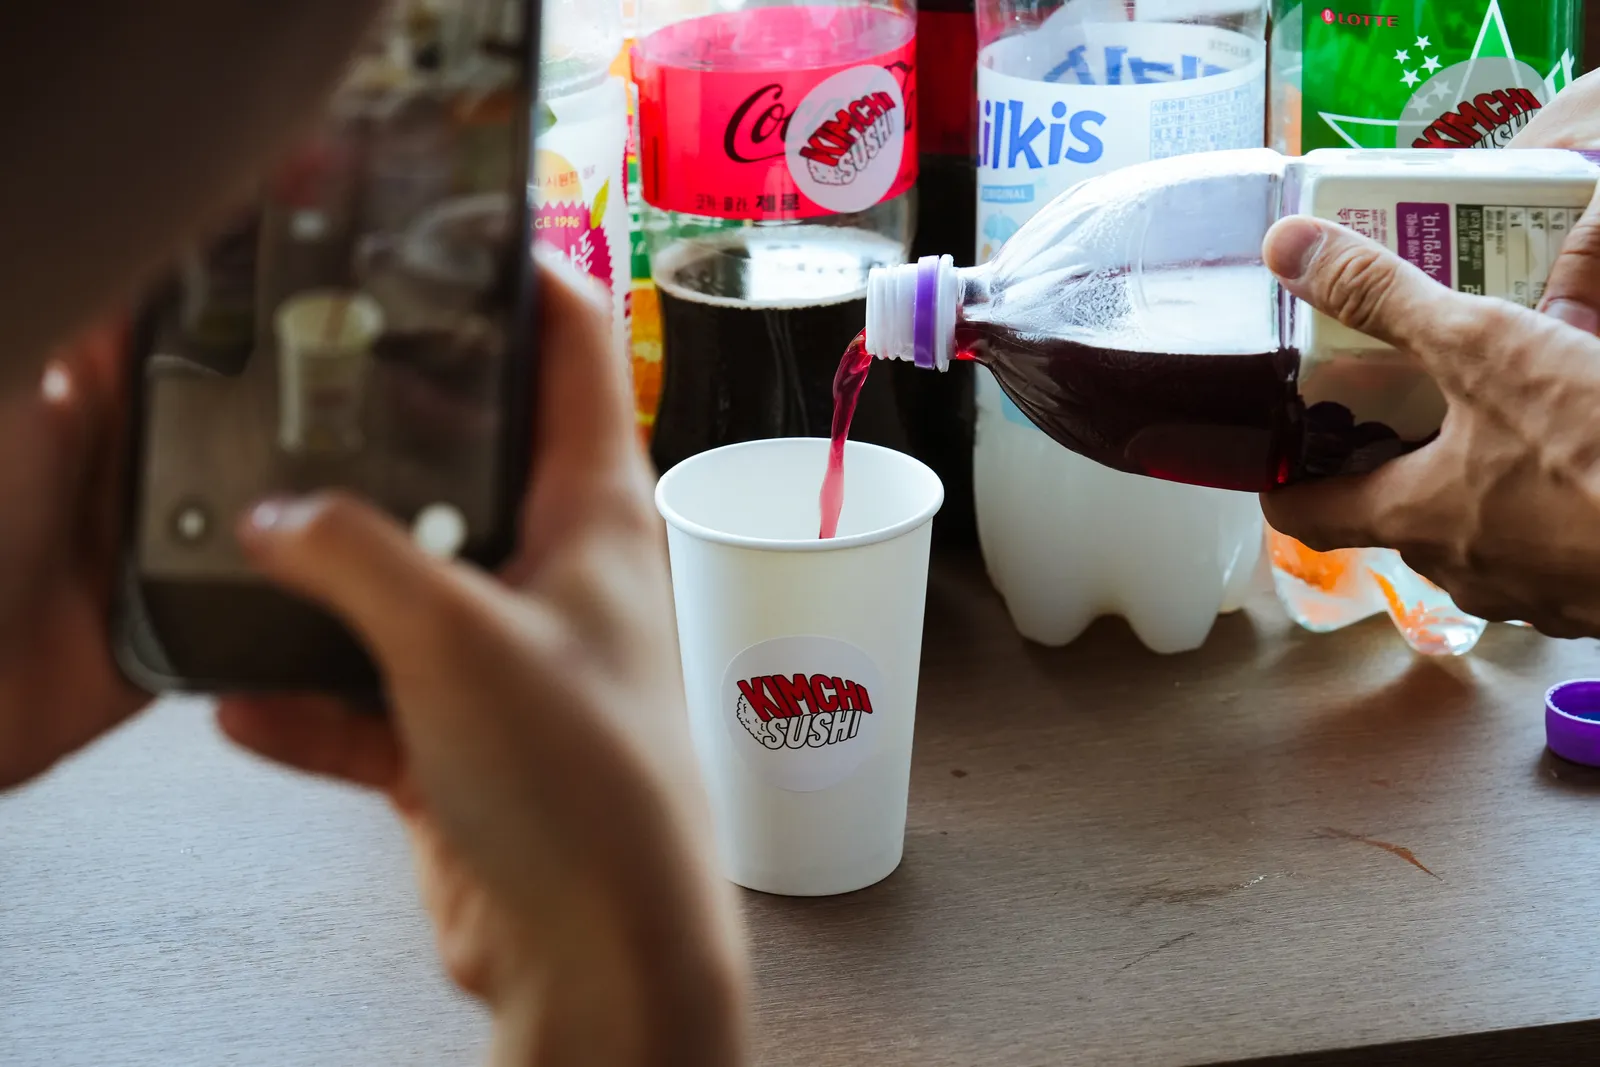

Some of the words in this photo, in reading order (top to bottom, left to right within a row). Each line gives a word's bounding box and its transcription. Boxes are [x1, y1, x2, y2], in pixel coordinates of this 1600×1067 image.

[1338, 12, 1398, 28] LOTTE
[799, 91, 897, 167] KIMCHI
[978, 99, 1107, 169] ilkis
[1411, 88, 1542, 148] KIMCHI
[837, 108, 894, 186] SUSHI
[555, 215, 579, 229] 1996
[756, 193, 799, 212] 제로
[1468, 209, 1481, 228] kcal
[1468, 230, 1481, 242] 40
[737, 673, 873, 722] KIMCHI
[762, 709, 863, 751] SUSHI
